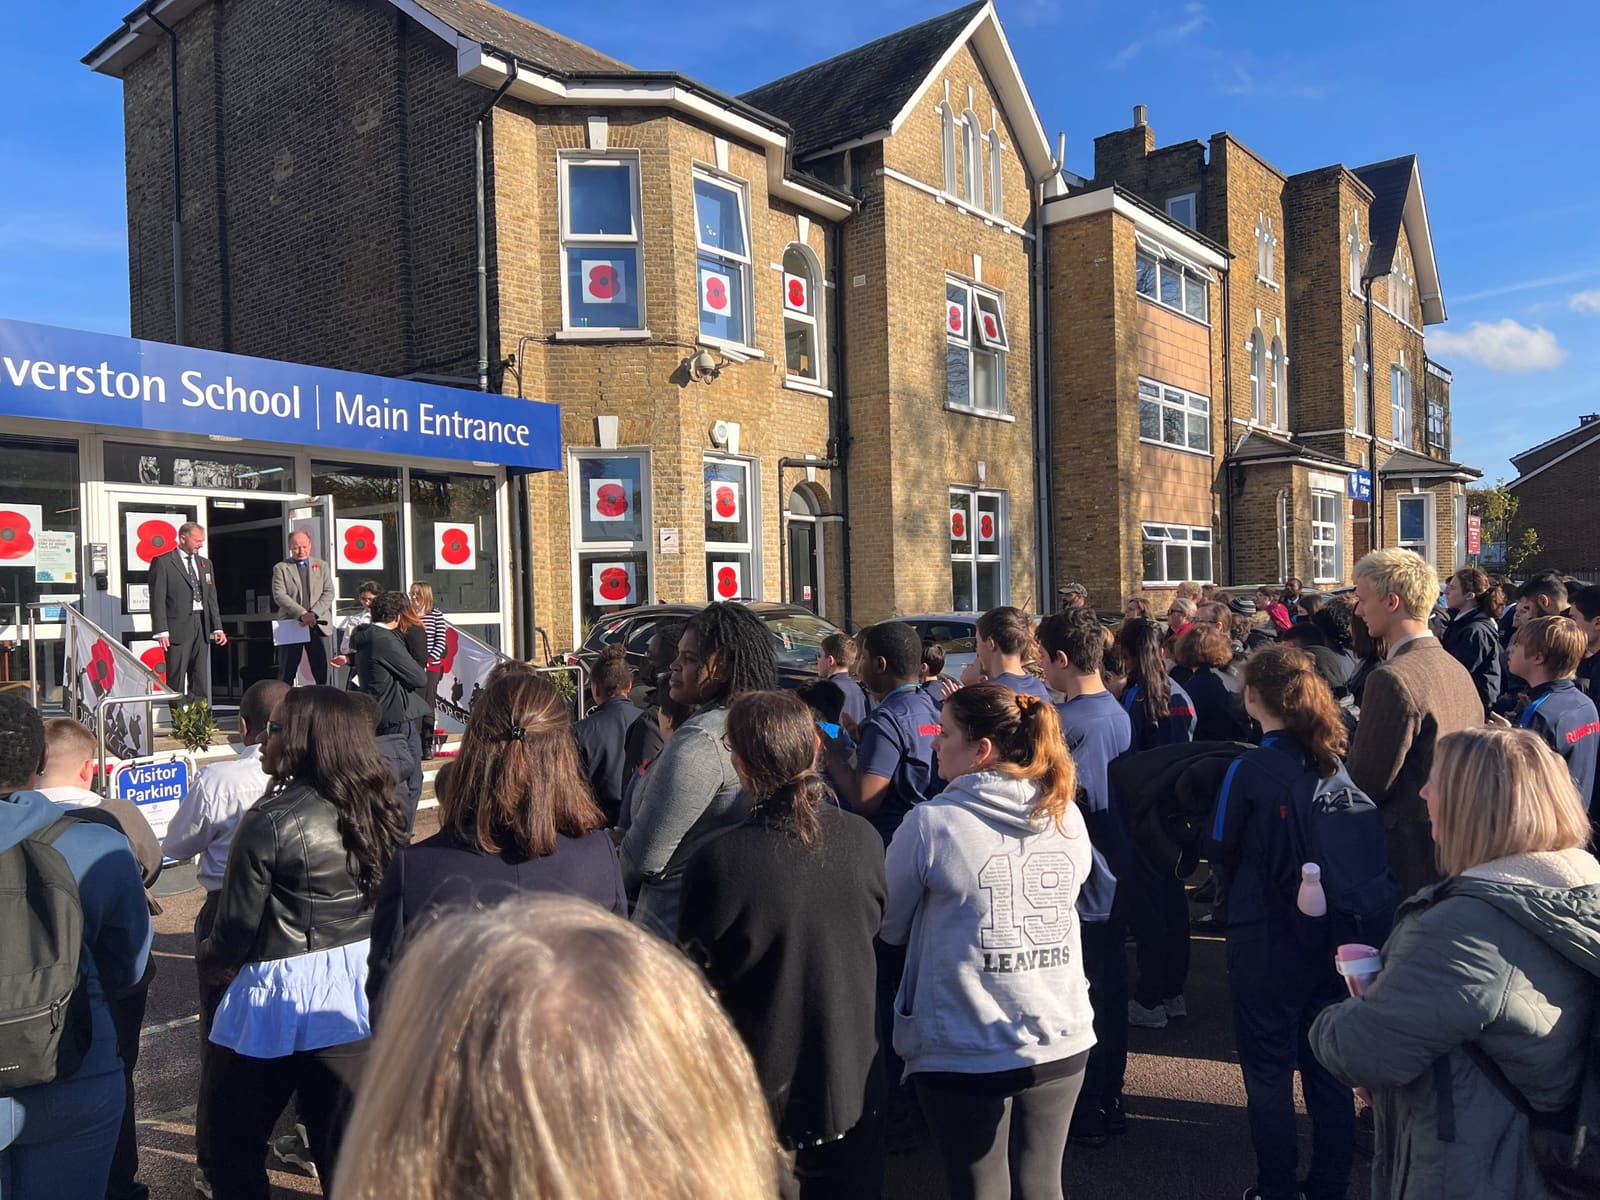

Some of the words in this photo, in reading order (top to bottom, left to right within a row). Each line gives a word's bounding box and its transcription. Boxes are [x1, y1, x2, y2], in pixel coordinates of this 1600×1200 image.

[1, 356, 166, 403] verston
[181, 370, 300, 419] School
[335, 391, 408, 432] Main
[419, 403, 530, 446] Entrance
[435, 698, 471, 725] FORGE
[128, 767, 177, 785] Visitor
[127, 784, 182, 802] Parking
[977, 851, 1075, 949] 19
[983, 945, 1070, 973] LEAVERS
